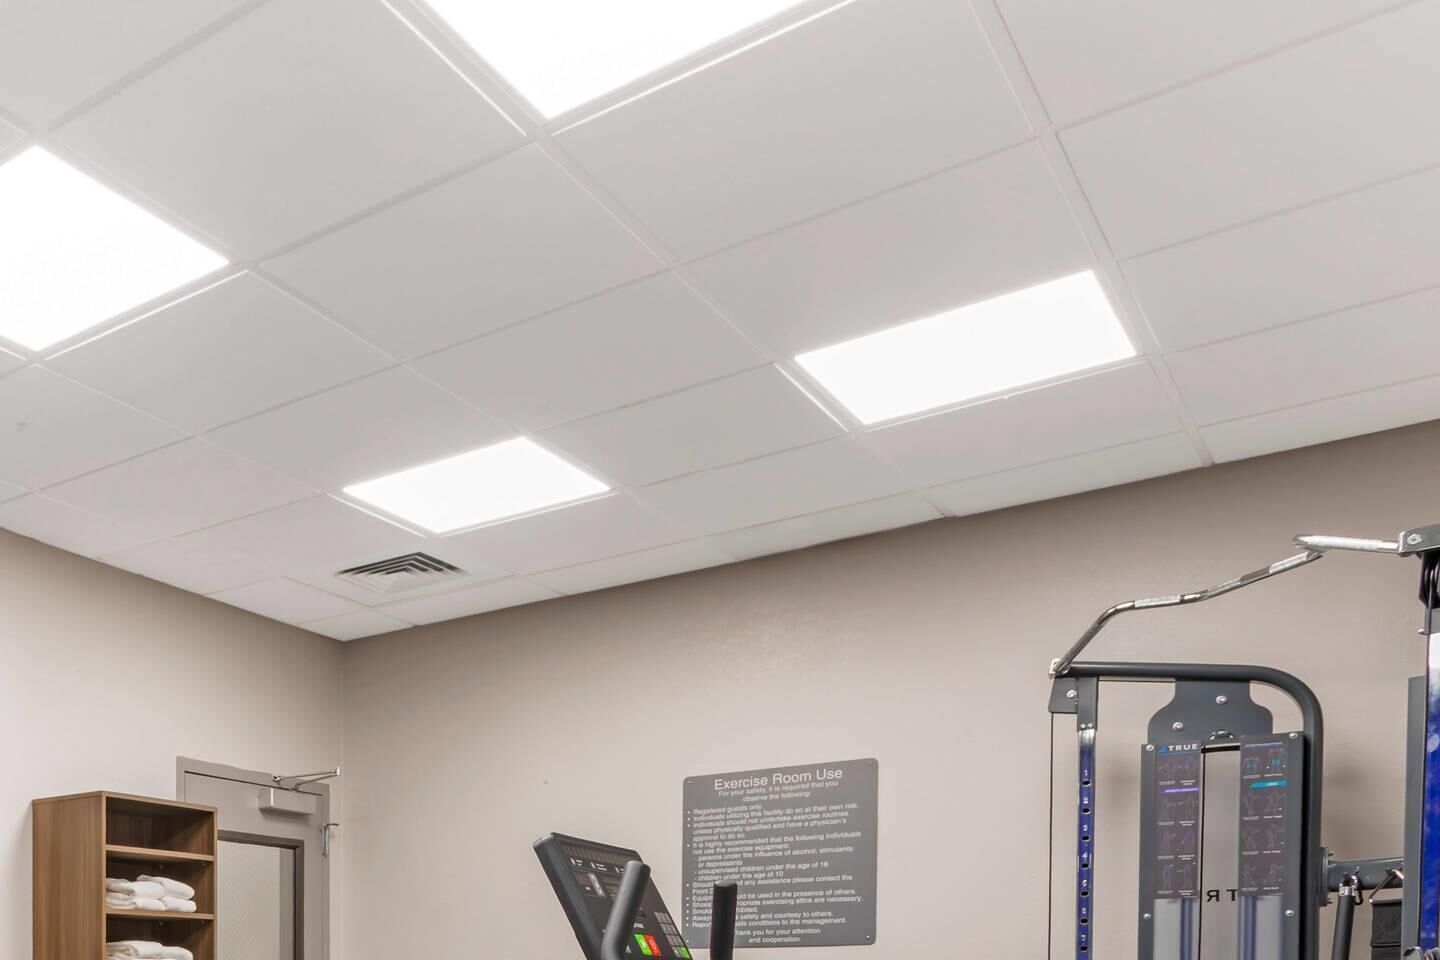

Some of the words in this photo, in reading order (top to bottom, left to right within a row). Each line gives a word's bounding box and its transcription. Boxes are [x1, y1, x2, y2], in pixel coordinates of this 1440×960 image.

[1168, 743, 1198, 752] TRUE
[714, 775, 769, 791] Exercise
[772, 772, 812, 785] Room
[816, 768, 843, 781] Use
[781, 783, 809, 791] required
[693, 807, 725, 815] Registered
[726, 811, 749, 819] utilizing
[713, 825, 742, 833] physically
[744, 823, 770, 831] qualified
[810, 818, 846, 826] physician's
[724, 837, 767, 845] recommended
[795, 833, 823, 841] following
[698, 866, 737, 874] unsupervised
